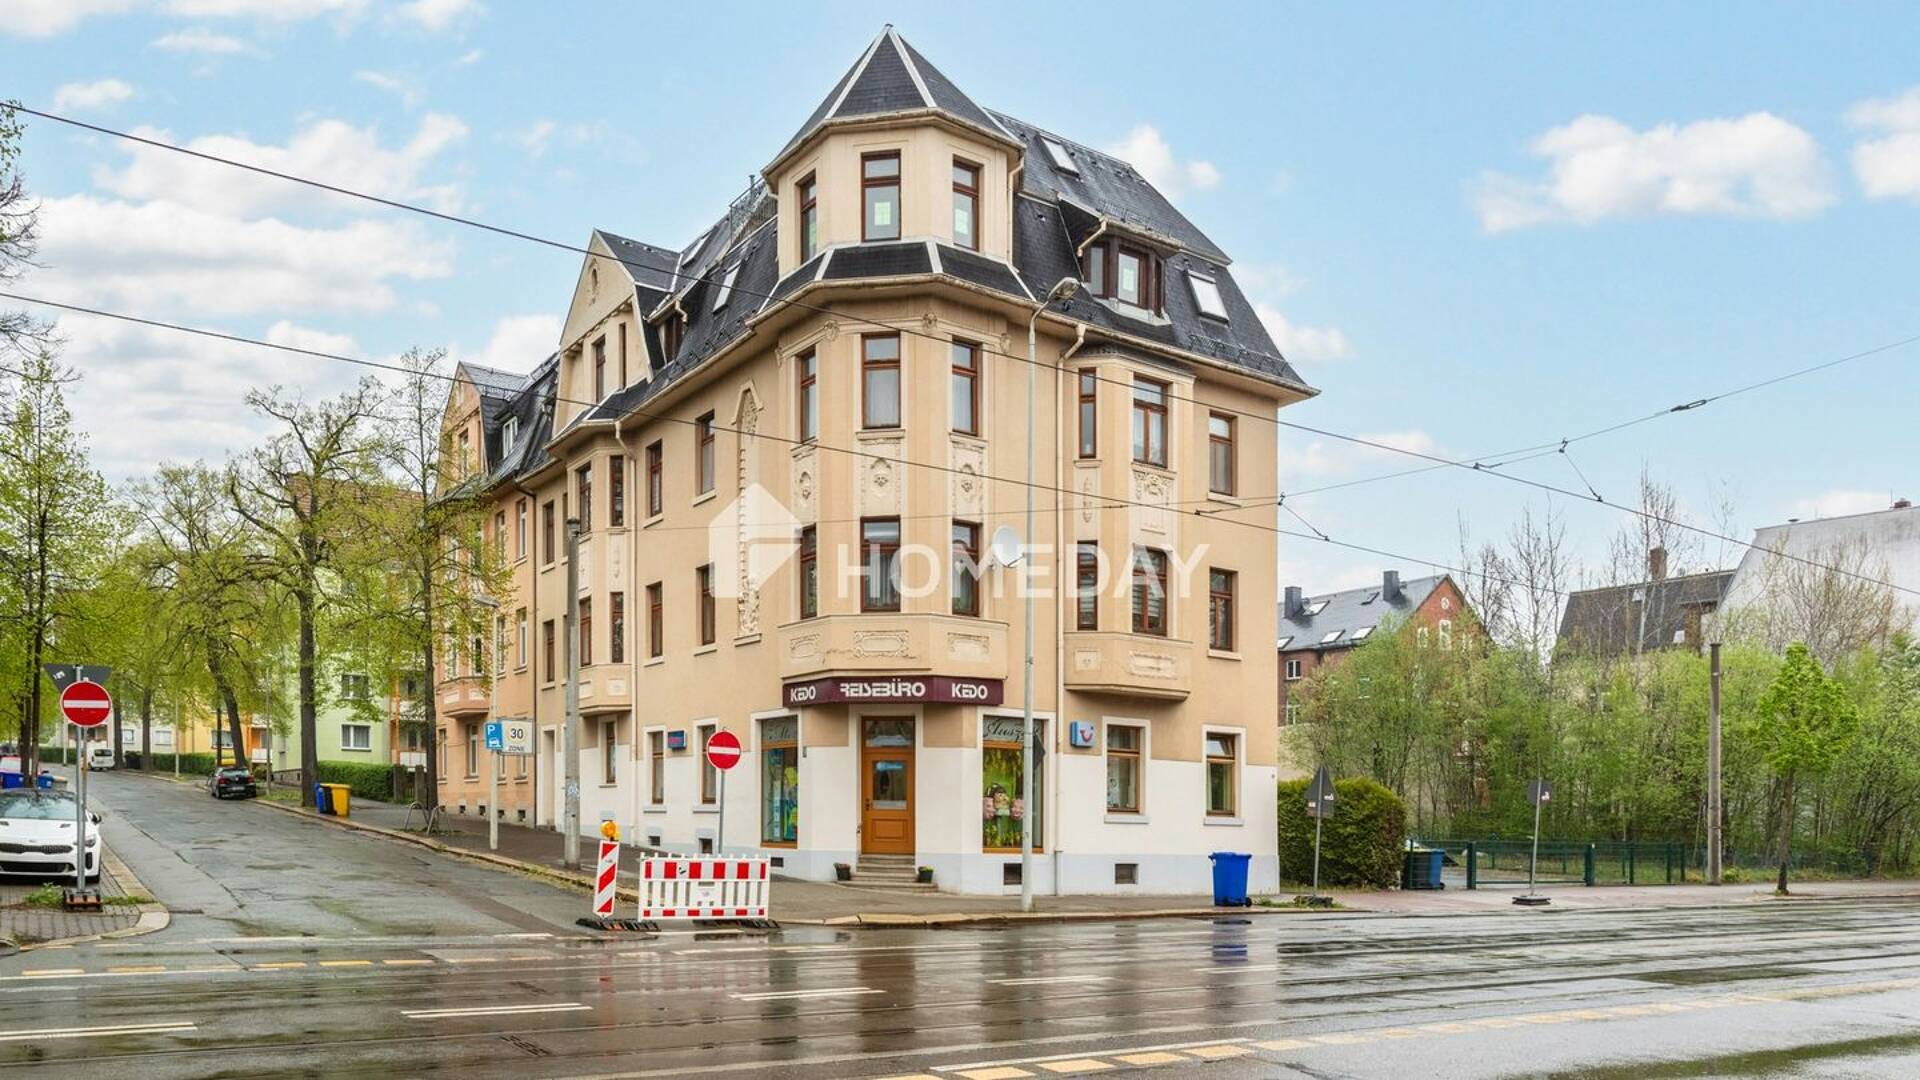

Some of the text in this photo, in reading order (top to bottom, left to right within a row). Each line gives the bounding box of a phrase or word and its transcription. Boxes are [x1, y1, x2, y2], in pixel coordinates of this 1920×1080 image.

[840, 678, 926, 697] REISEBÜRO
[951, 683, 988, 699] KEDO
[510, 728, 524, 740] 30
